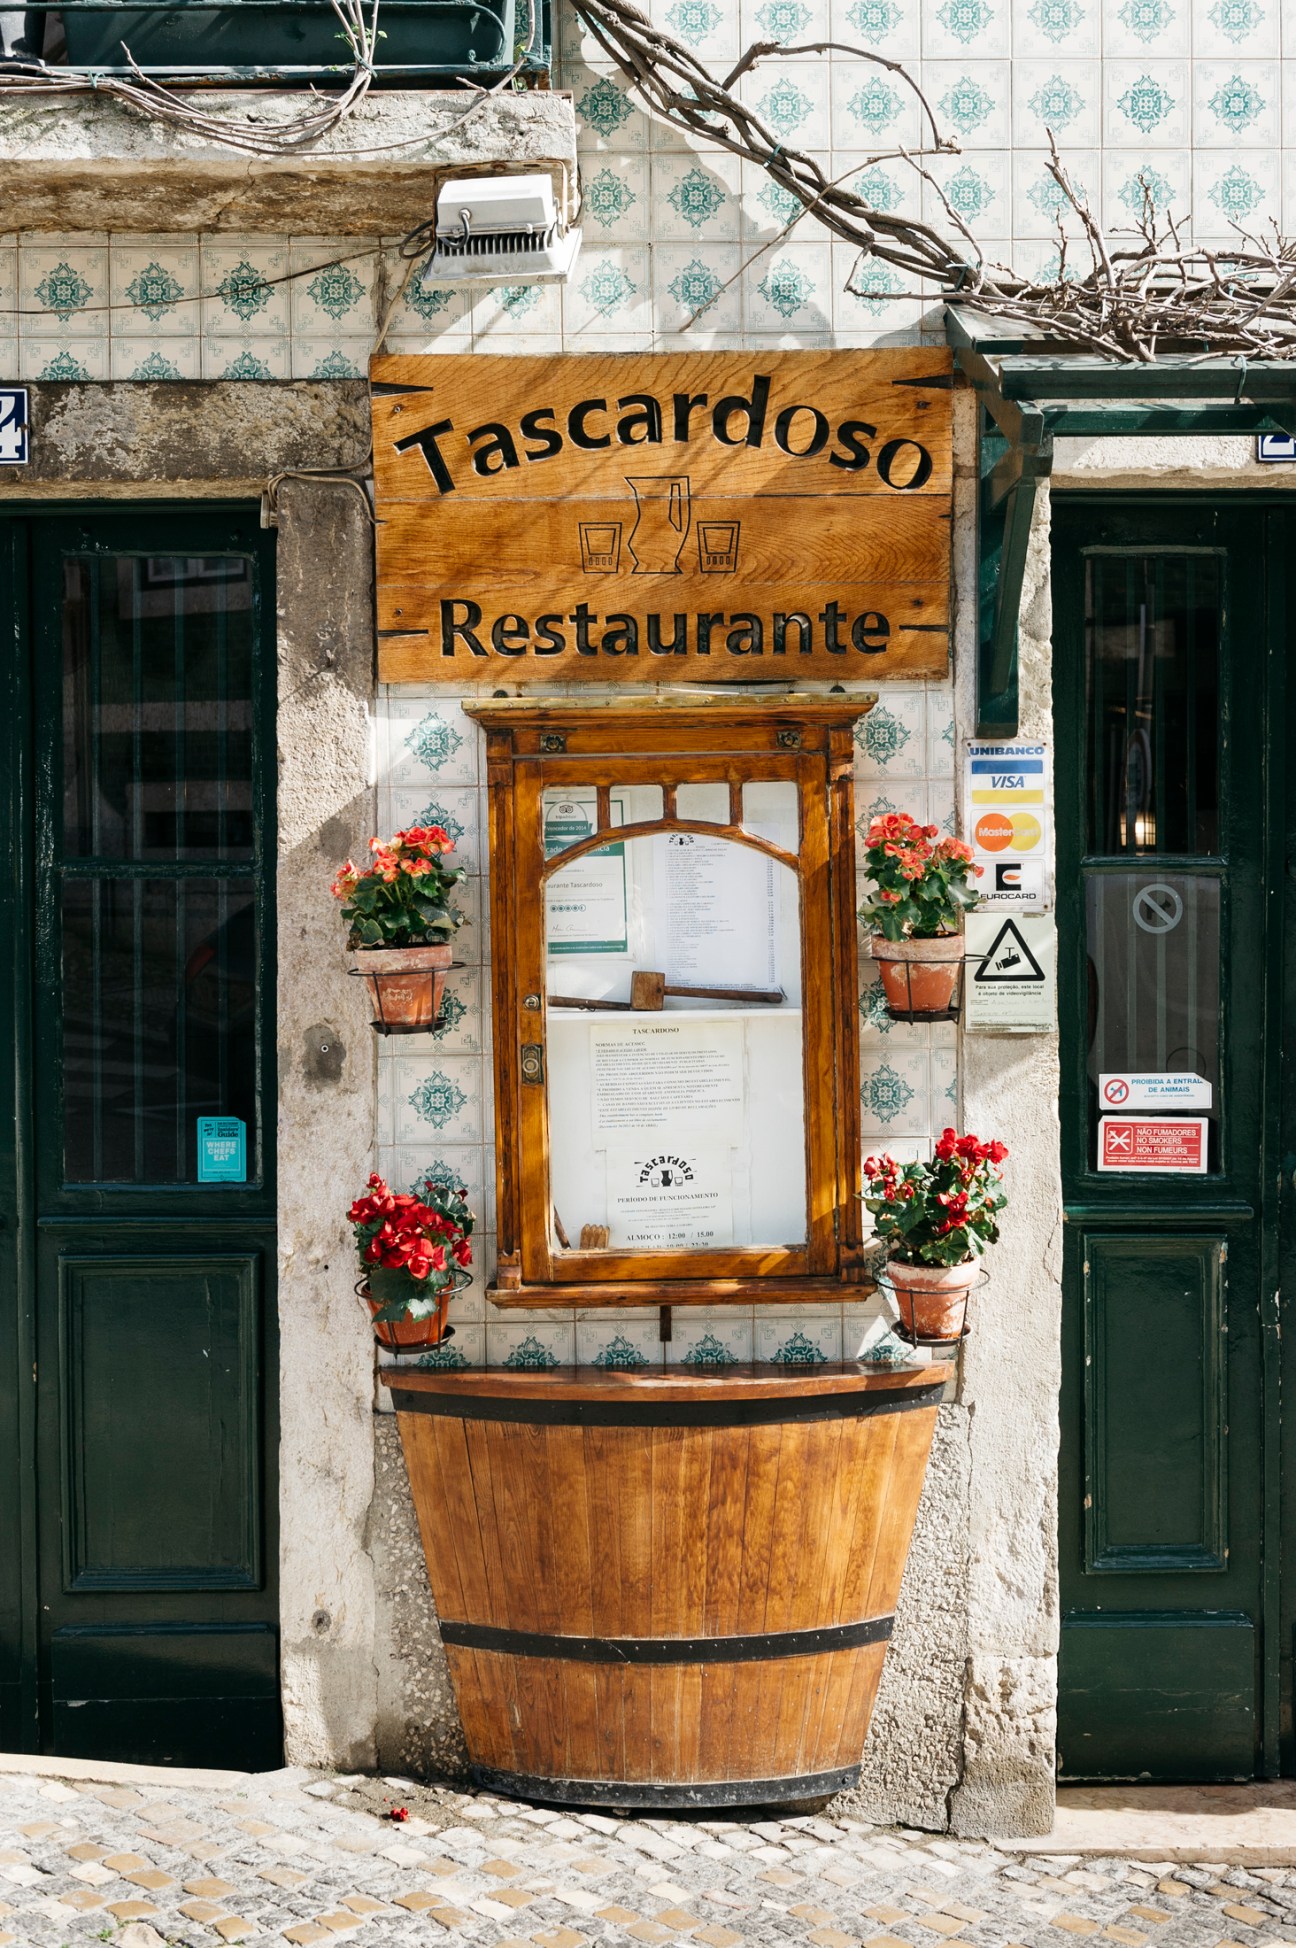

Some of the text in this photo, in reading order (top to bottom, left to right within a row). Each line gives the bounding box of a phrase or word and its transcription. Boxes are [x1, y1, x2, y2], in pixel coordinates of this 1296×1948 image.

[393, 374, 933, 495] Tascardoso
[440, 598, 892, 658] Restaurante
[970, 746, 1045, 756] UNIBANCO
[991, 775, 1025, 788] VISA
[978, 827, 1038, 837] MasterCard
[980, 892, 1037, 900] EUROCARD
[1136, 1127, 1196, 1137] NÃO FUMADORES
[1148, 1137, 1182, 1145] SMOKERS
[1136, 1146, 1188, 1154] NON FUMEURS
[639, 1155, 694, 1183] Tascardoso
[659, 1192, 719, 1201] FUNCIONAMENTO
[626, 1234, 660, 1242] ALMOÇO
